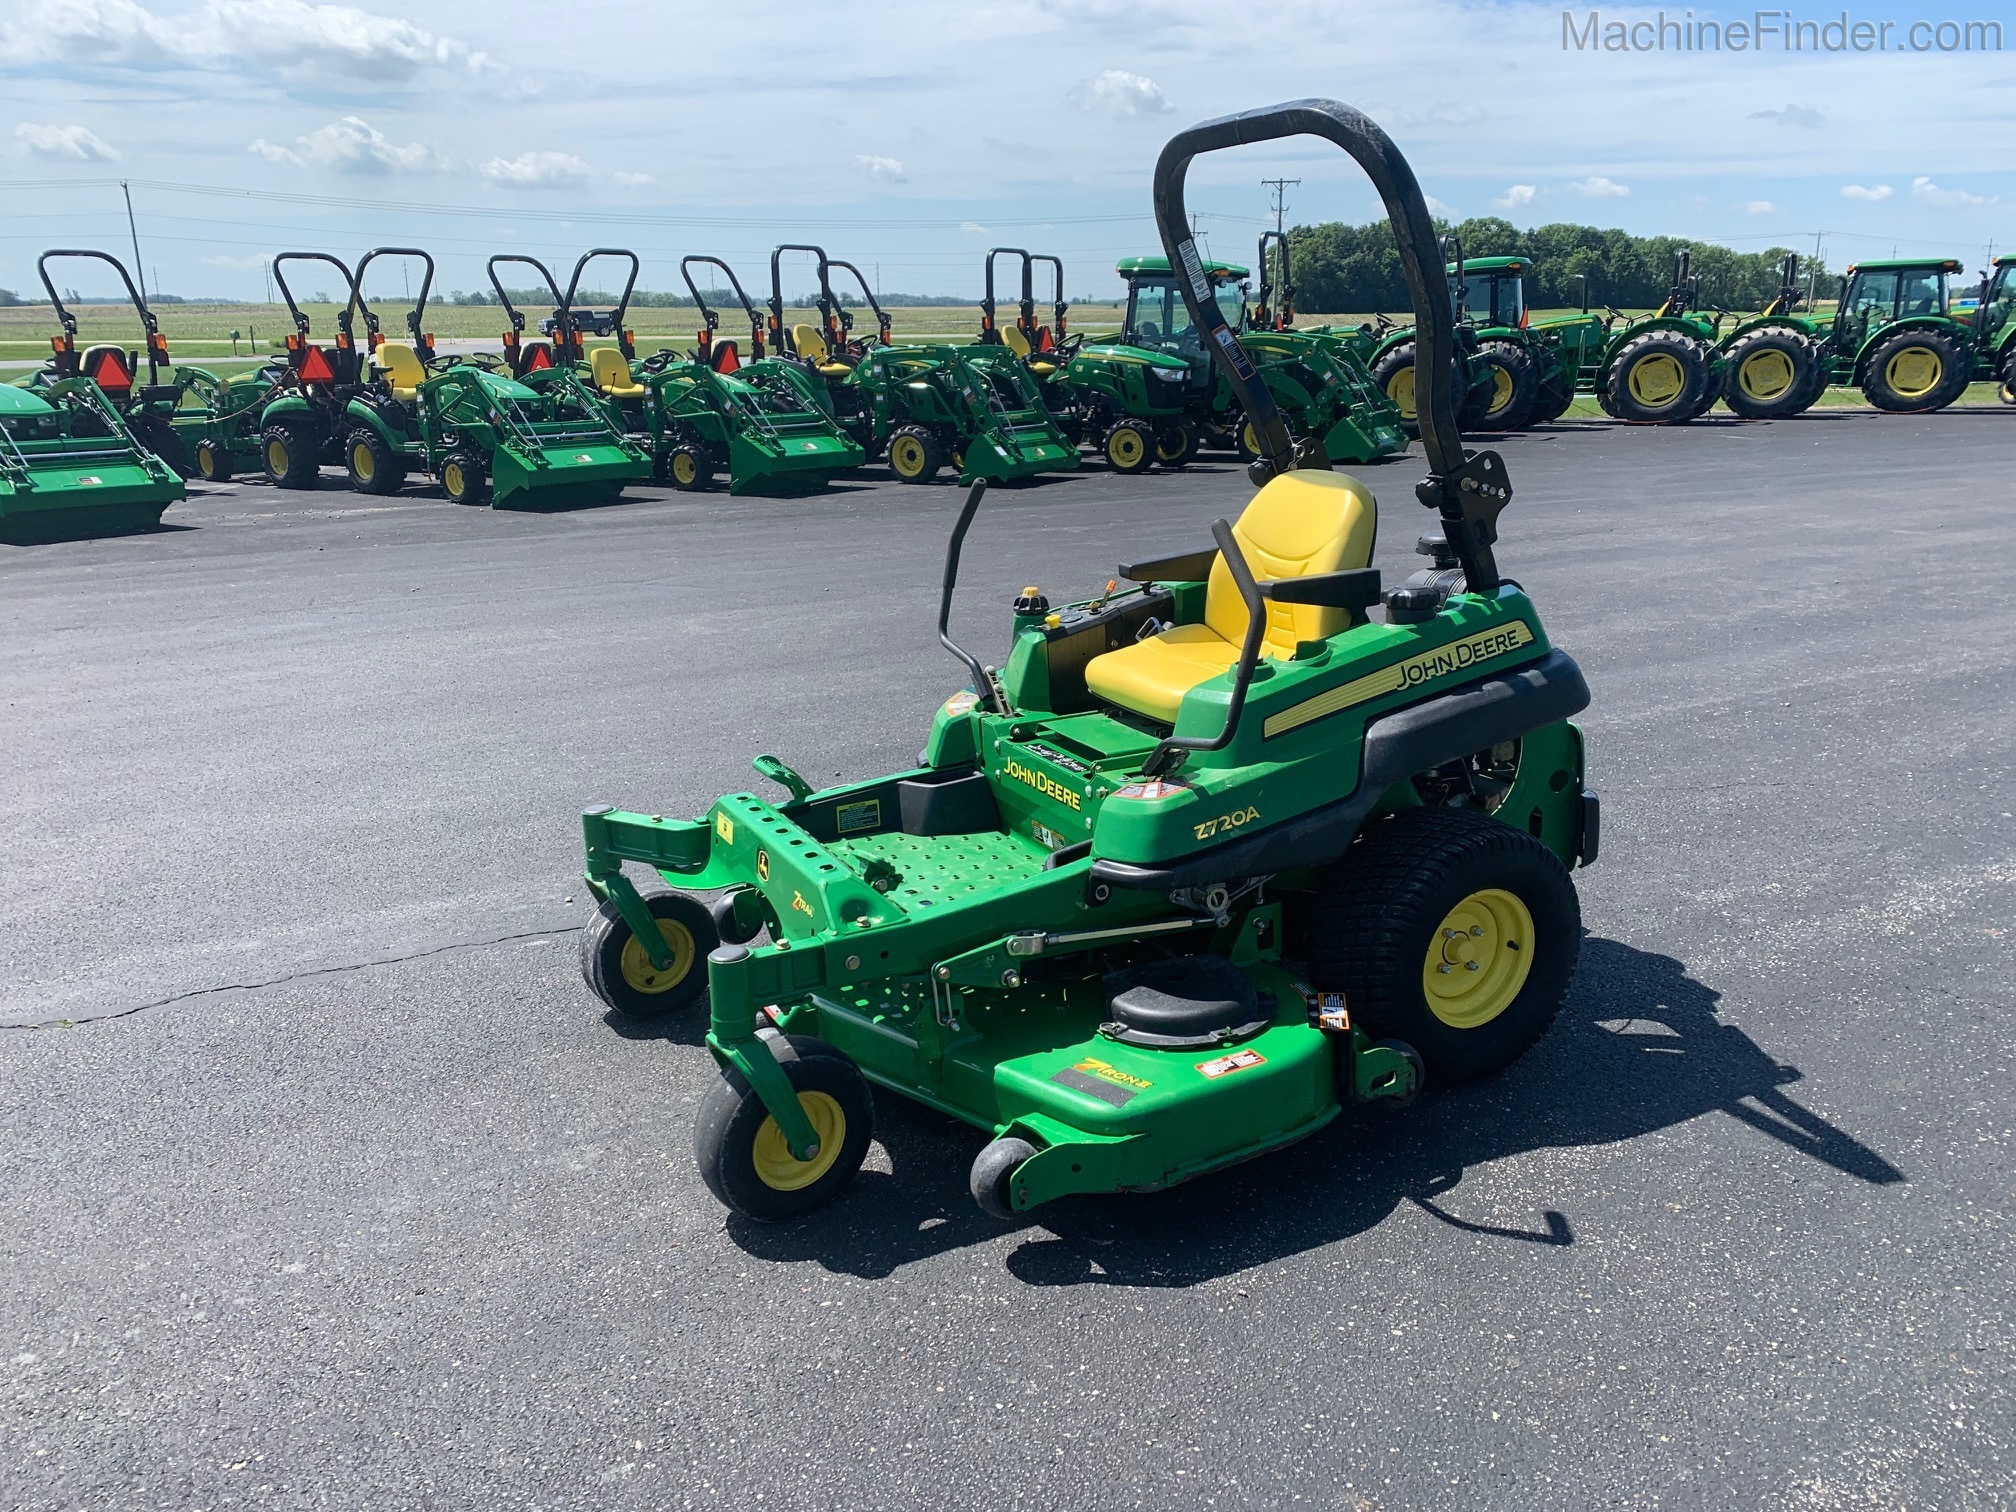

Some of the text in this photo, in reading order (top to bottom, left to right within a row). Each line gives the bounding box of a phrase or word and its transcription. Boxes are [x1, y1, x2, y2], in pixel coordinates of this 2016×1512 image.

[1397, 630, 1519, 688] JOHN DEERE
[1003, 757, 1037, 788] JOHN
[1037, 771, 1082, 811] DEERE
[1193, 805, 1261, 840] Z720A
